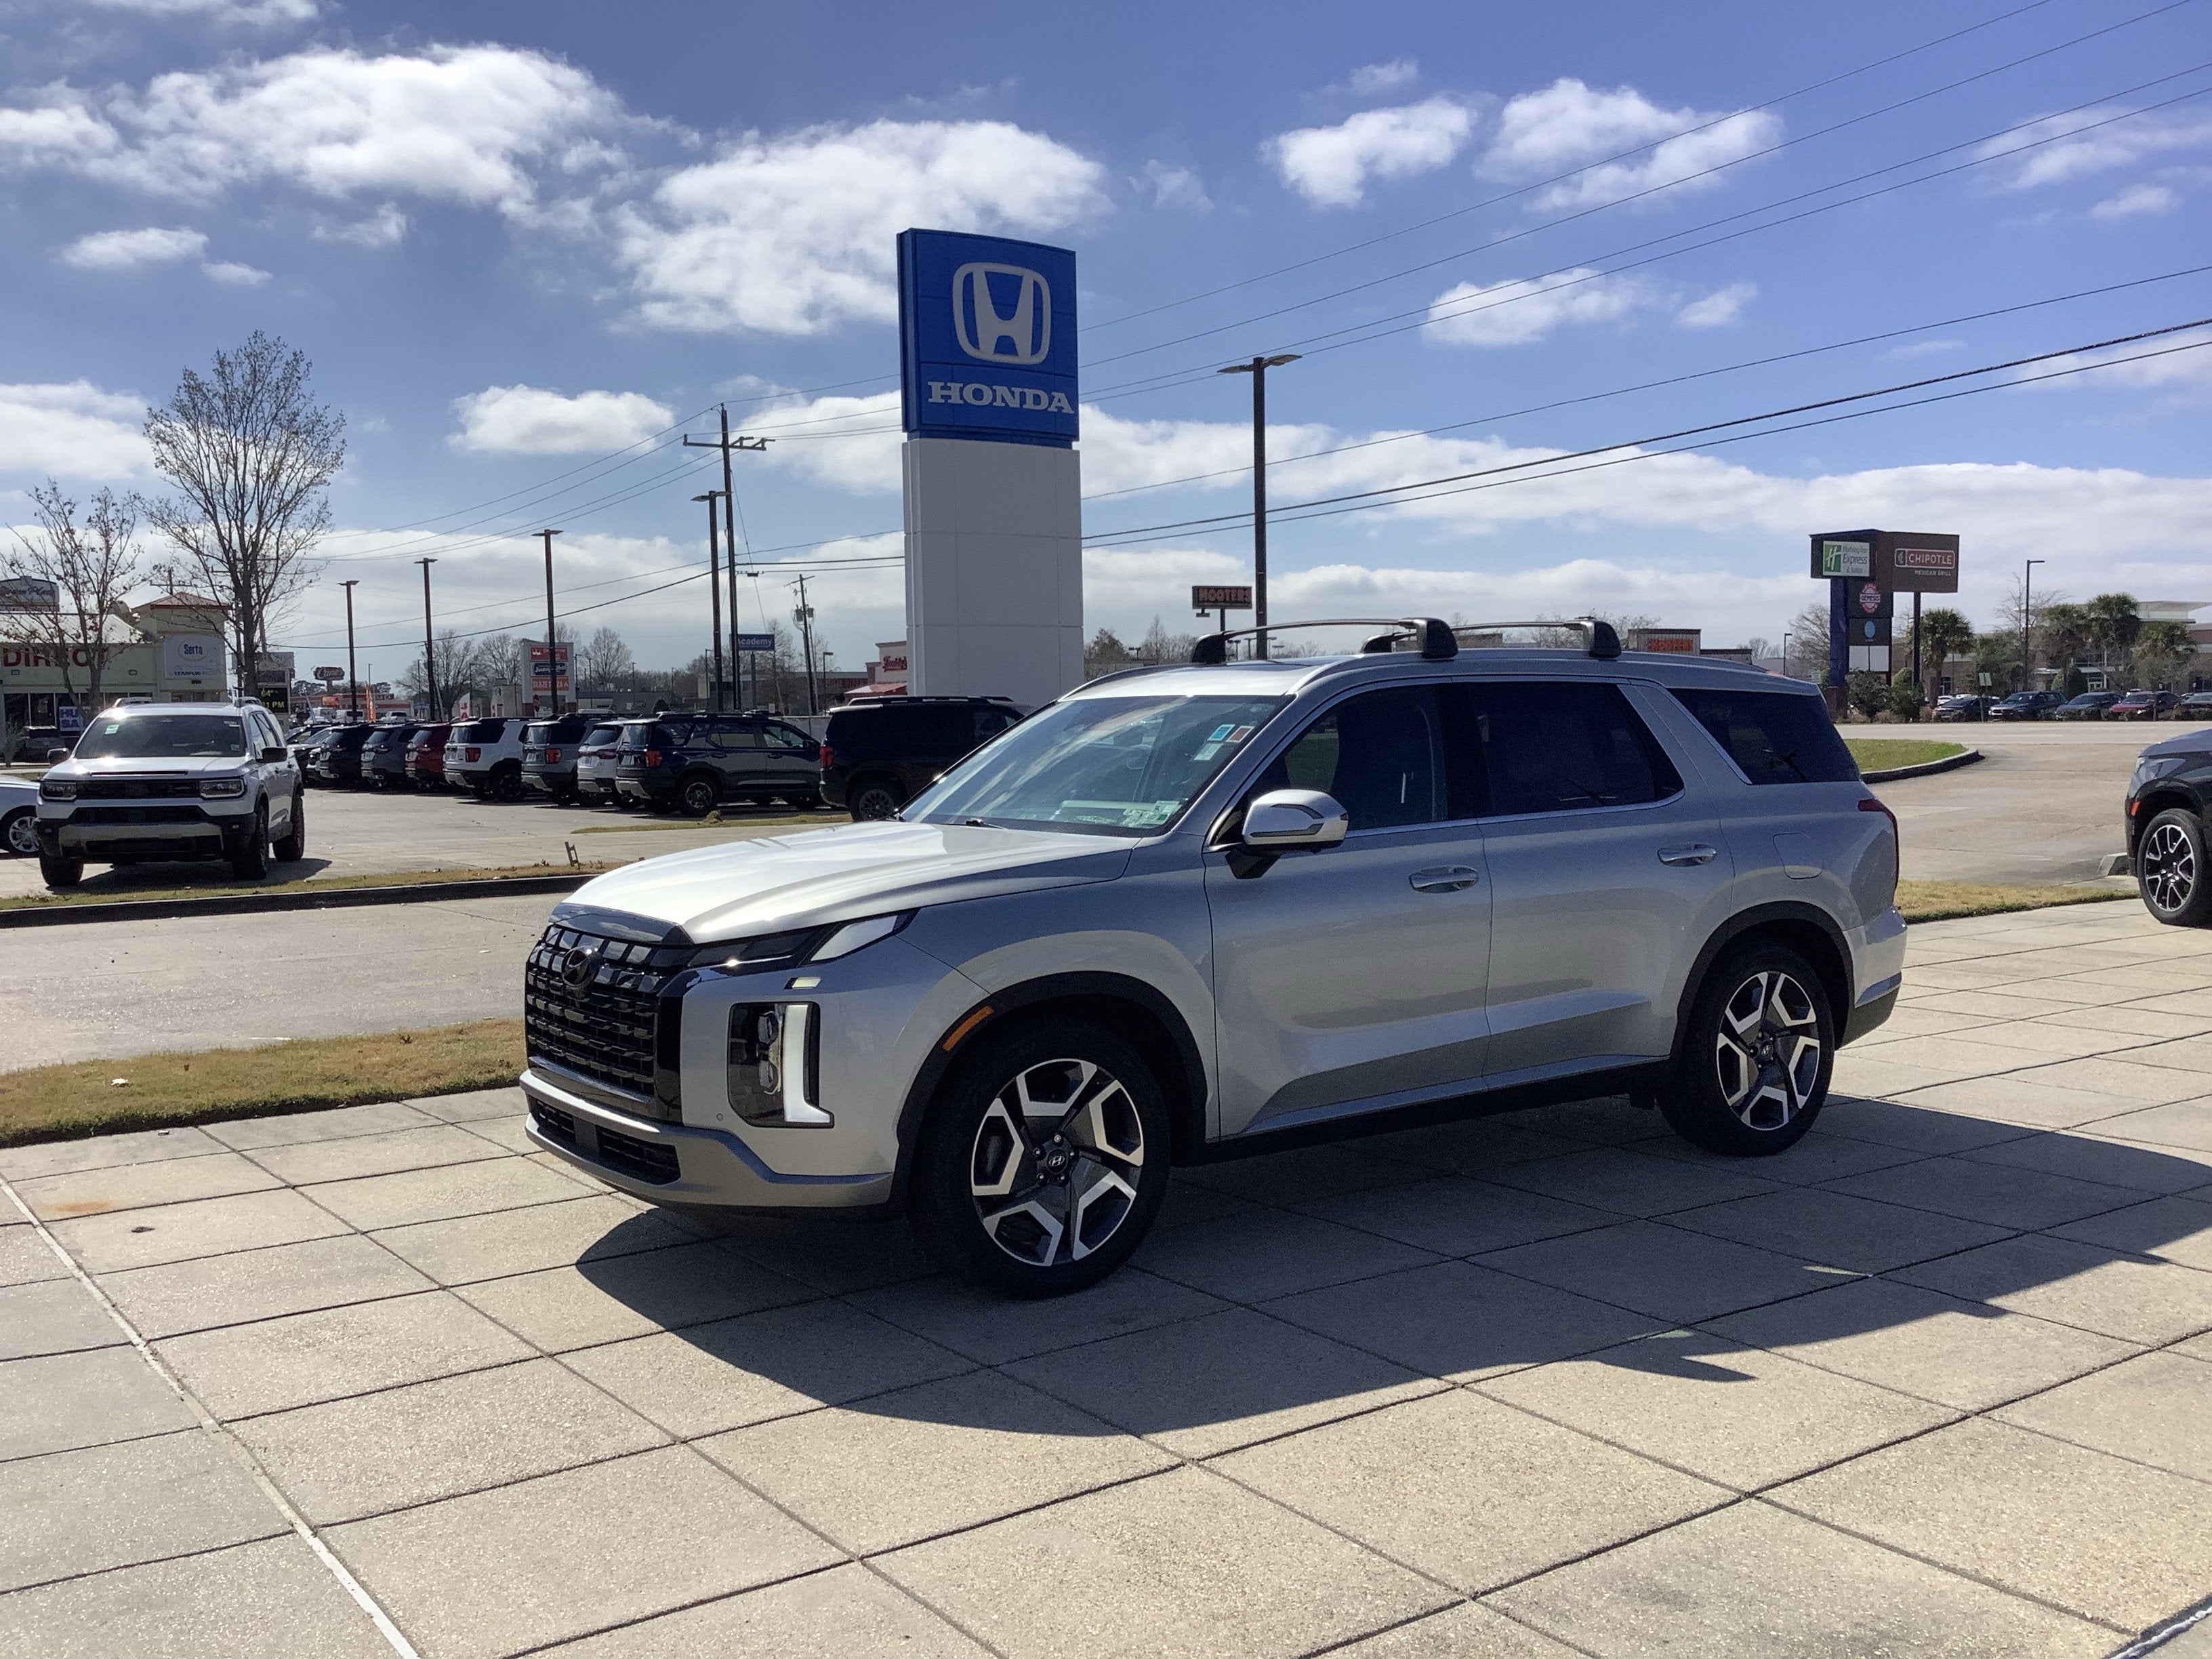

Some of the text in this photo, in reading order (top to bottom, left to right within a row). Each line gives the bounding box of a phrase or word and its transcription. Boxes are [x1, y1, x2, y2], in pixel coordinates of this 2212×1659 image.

[928, 382, 1074, 414] HONDA
[1843, 554, 1867, 565] Express
[1908, 554, 1952, 564] CHIPOTLE
[1199, 588, 1252, 602] HOOTERS
[184, 644, 203, 655] Serta
